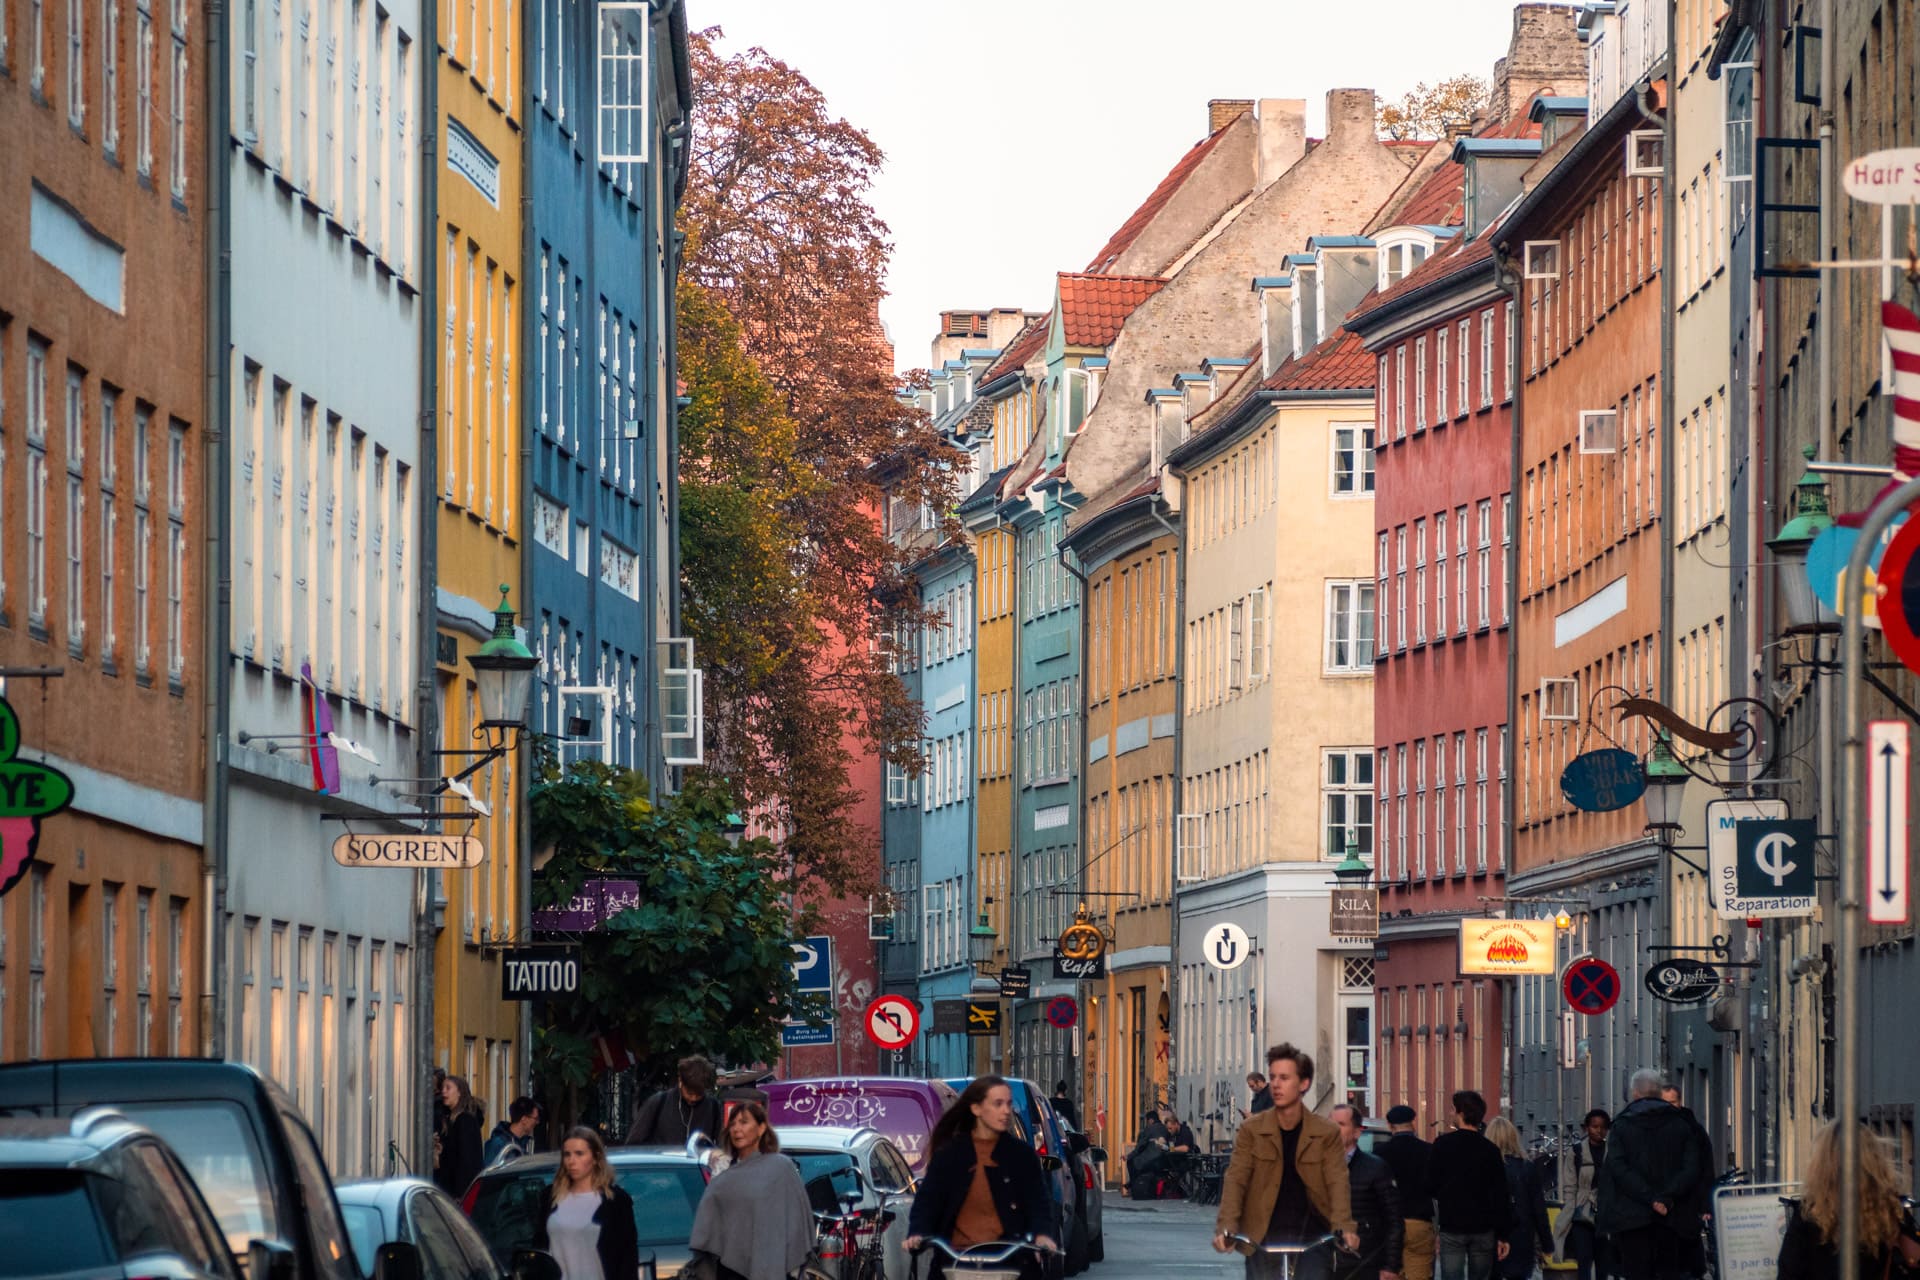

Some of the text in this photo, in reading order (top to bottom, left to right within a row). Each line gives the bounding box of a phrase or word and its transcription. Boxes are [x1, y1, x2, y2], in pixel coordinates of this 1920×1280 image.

[1854, 164, 1904, 185] Hair
[1339, 899, 1372, 911] KILA
[1725, 897, 1810, 914] Reparation
[789, 943, 819, 981] P
[1060, 959, 1099, 978] Café
[506, 961, 577, 993] TATTOO
